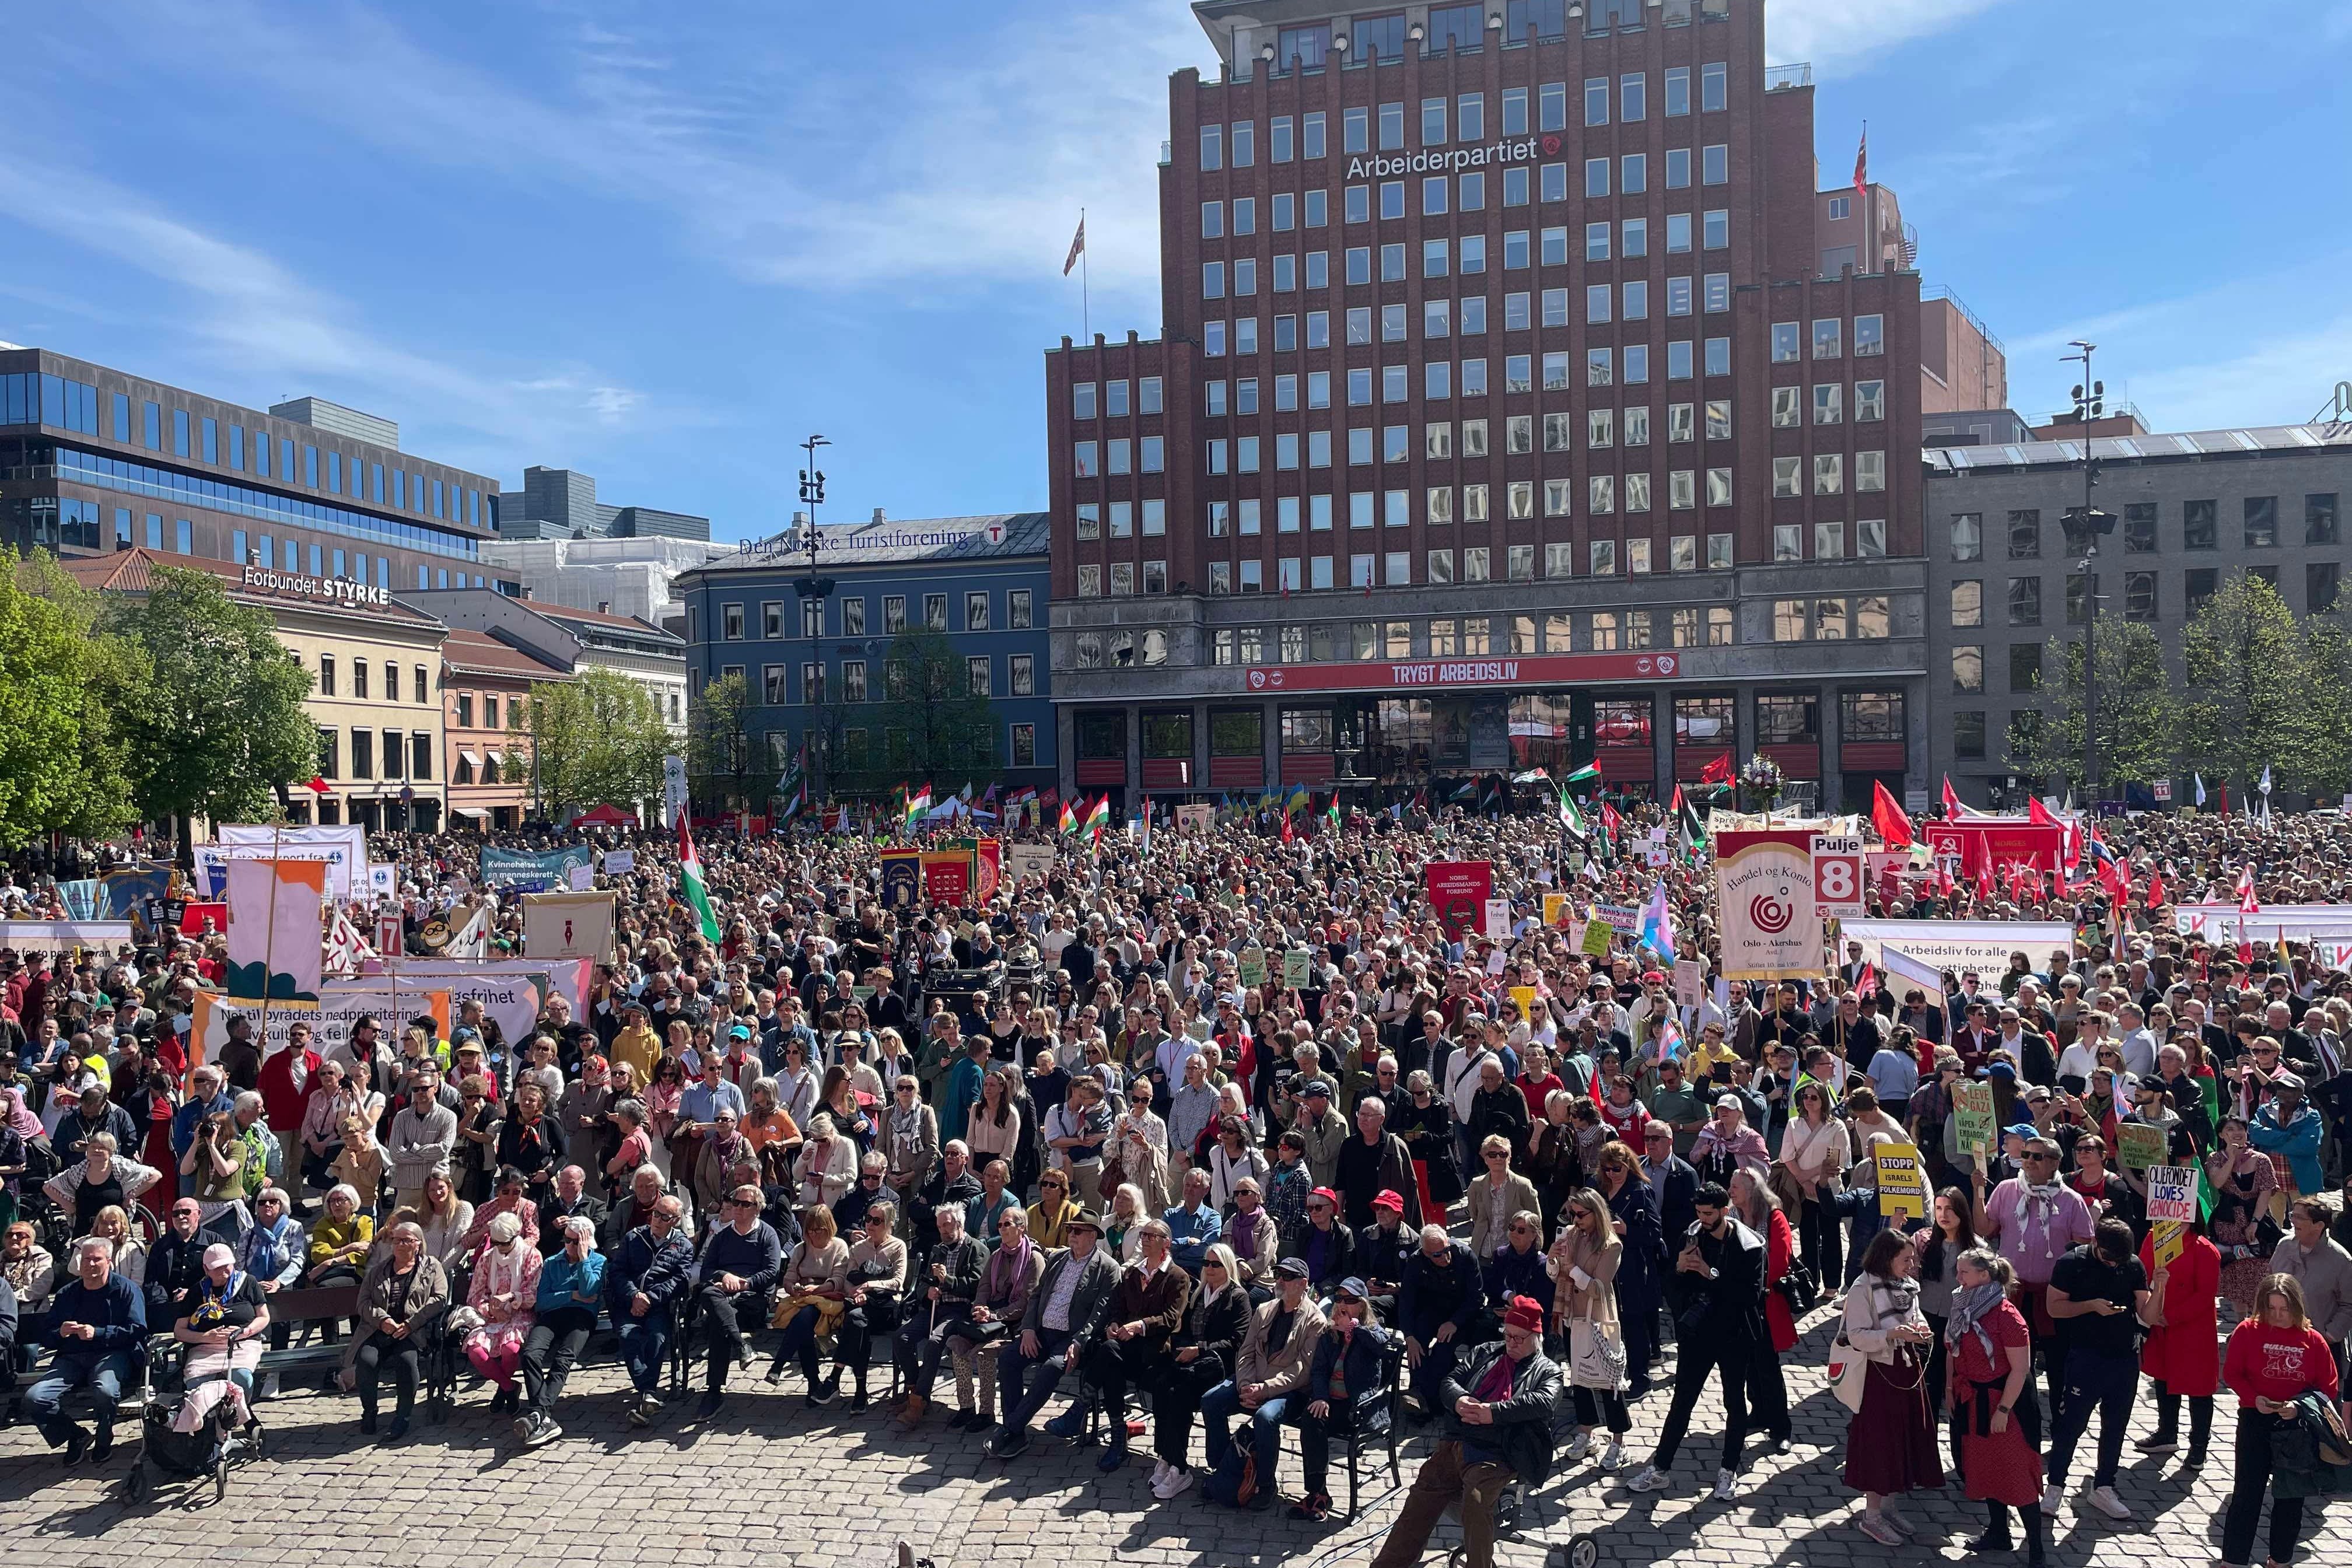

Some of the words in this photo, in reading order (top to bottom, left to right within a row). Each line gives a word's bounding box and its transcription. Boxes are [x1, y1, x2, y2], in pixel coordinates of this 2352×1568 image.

[1347, 137, 1537, 179] Arbeiderpartiet
[739, 538, 773, 555] Den
[780, 536, 839, 554] Noske
[847, 529, 968, 551] Turistforening
[245, 566, 317, 594] Forbundet
[323, 578, 390, 607] STYRKE
[1392, 665, 1436, 684] TRYGT
[1439, 662, 1518, 682] ARBEIDSLIV
[1815, 838, 1859, 852] Pulje
[488, 860, 536, 869] Kvinnehelse
[1726, 866, 1762, 891] Handel
[1765, 867, 1779, 877] og
[1782, 866, 1812, 888] Konto
[1821, 860, 1854, 899] 8
[382, 902, 398, 914] Pulje
[1597, 907, 1620, 916] TRANS
[2179, 915, 2208, 933] SV
[384, 921, 398, 952] 7
[1743, 939, 1761, 947] Oslo
[1903, 945, 1962, 956] Arbeidsliv
[1965, 946, 1983, 956] for
[1986, 947, 2007, 957] alle
[247, 1009, 261, 1021] til
[326, 1007, 421, 1021] nedprioritering
[1969, 1088, 1989, 1101] LEVE
[1970, 1101, 1991, 1114] GAZA
[1959, 1129, 1985, 1139] EMBARGO
[1881, 1158, 1913, 1170] STOPP
[1885, 1174, 1912, 1182] ISRAELS
[2149, 1167, 2196, 1187] OLJEFONDET
[1880, 1186, 1920, 1195] FOLKEMORD
[2154, 1186, 2184, 1201] LOVES
[2148, 1200, 2191, 1220] GENOCIDE
